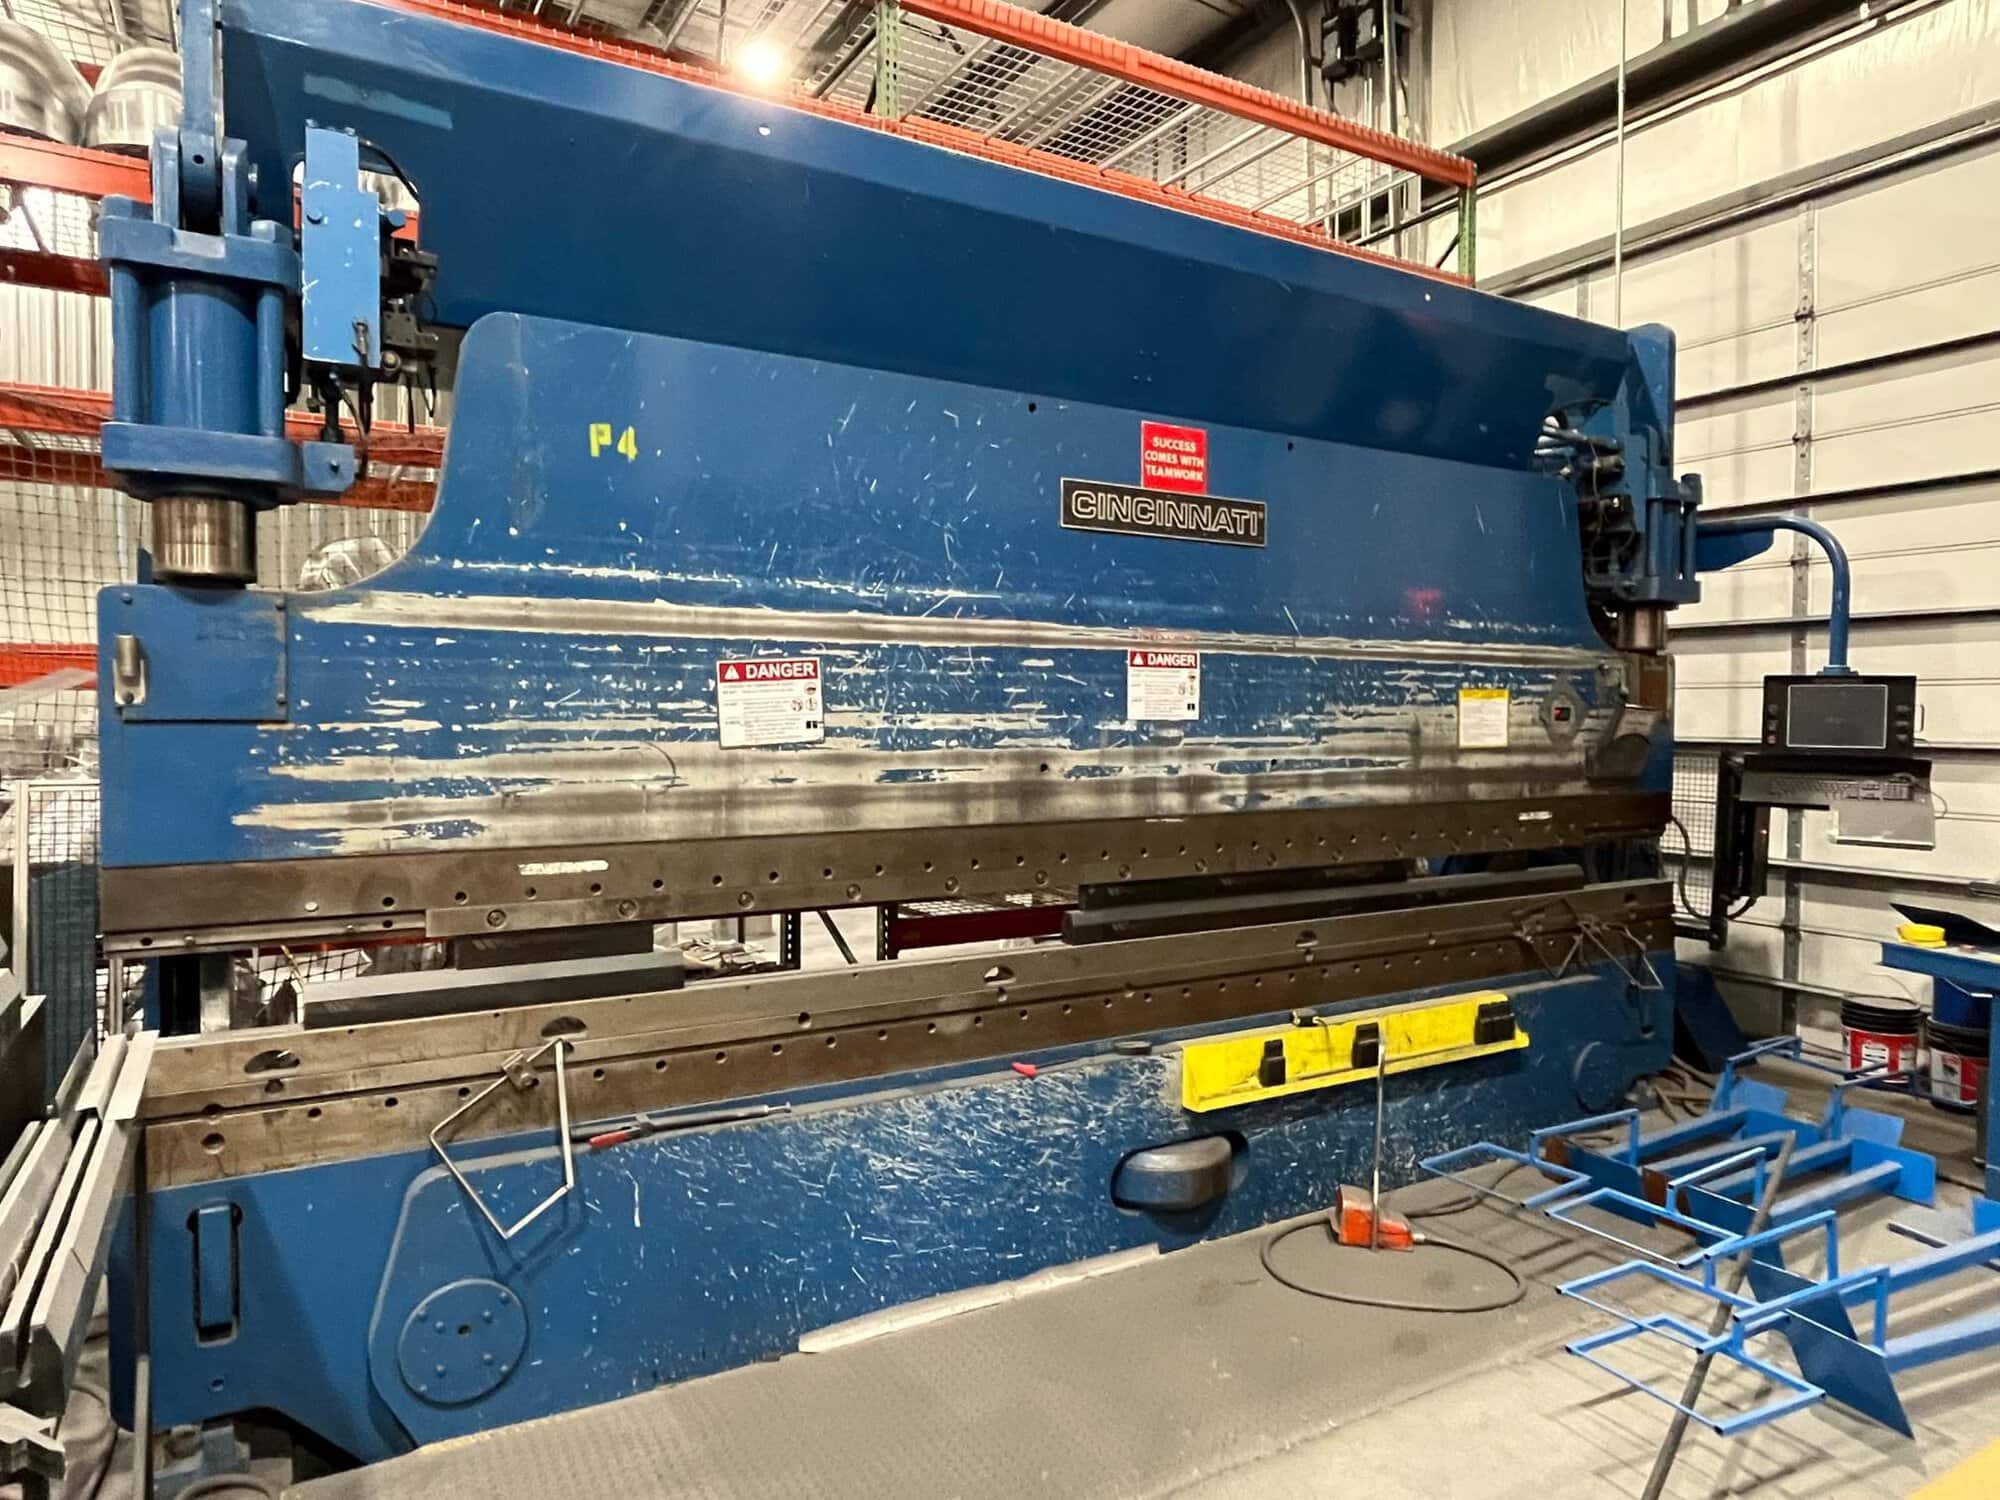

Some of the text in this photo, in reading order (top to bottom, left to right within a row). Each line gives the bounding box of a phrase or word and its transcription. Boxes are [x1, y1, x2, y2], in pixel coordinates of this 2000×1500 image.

[589, 423, 638, 462] P4
[1152, 436, 1196, 453] SUCCESS
[1144, 450, 1204, 467] COMES WITH
[1145, 465, 1204, 482] TEAMWORK
[1071, 490, 1259, 536] CINCINNATI
[1147, 653, 1196, 667] DANGER
[745, 662, 815, 679] DANGER
